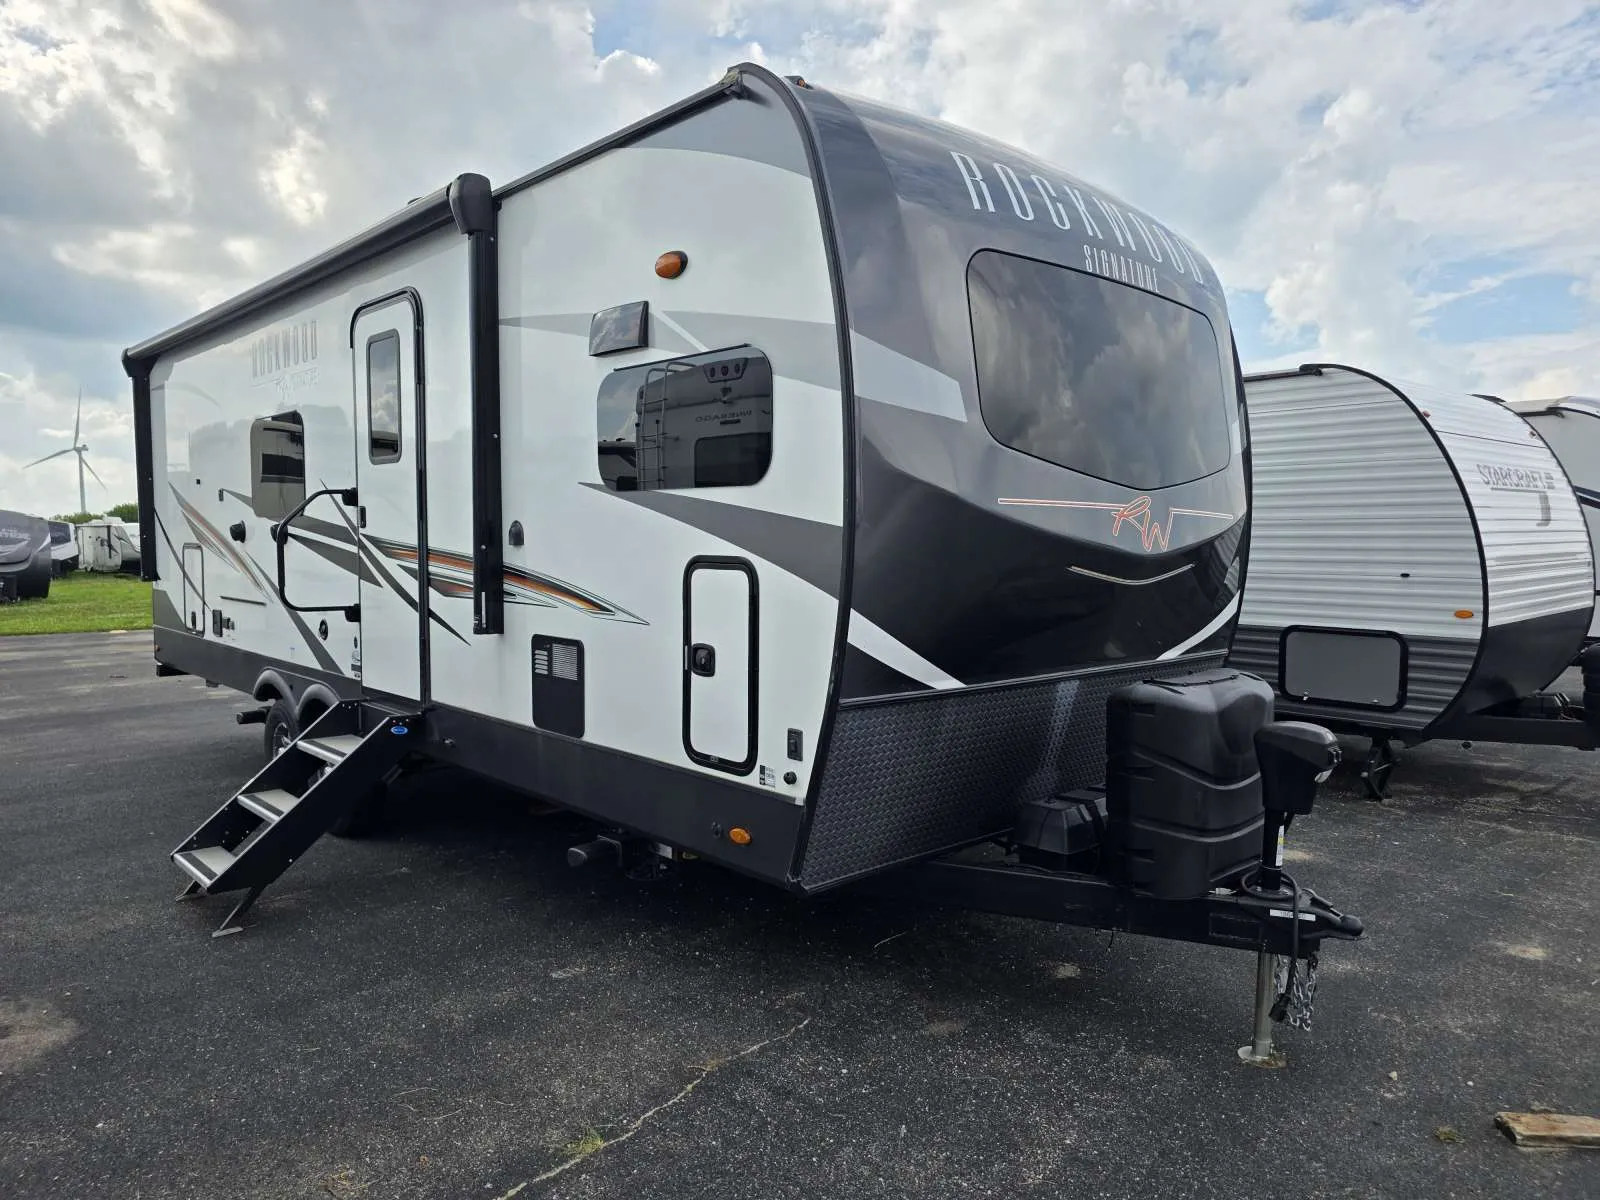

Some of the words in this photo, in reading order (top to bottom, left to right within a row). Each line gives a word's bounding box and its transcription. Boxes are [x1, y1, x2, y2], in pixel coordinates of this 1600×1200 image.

[951, 151, 1204, 284] ROCKWOOD
[1083, 244, 1160, 293] SIGNATURE
[1476, 464, 1546, 489] STARCRAFT
